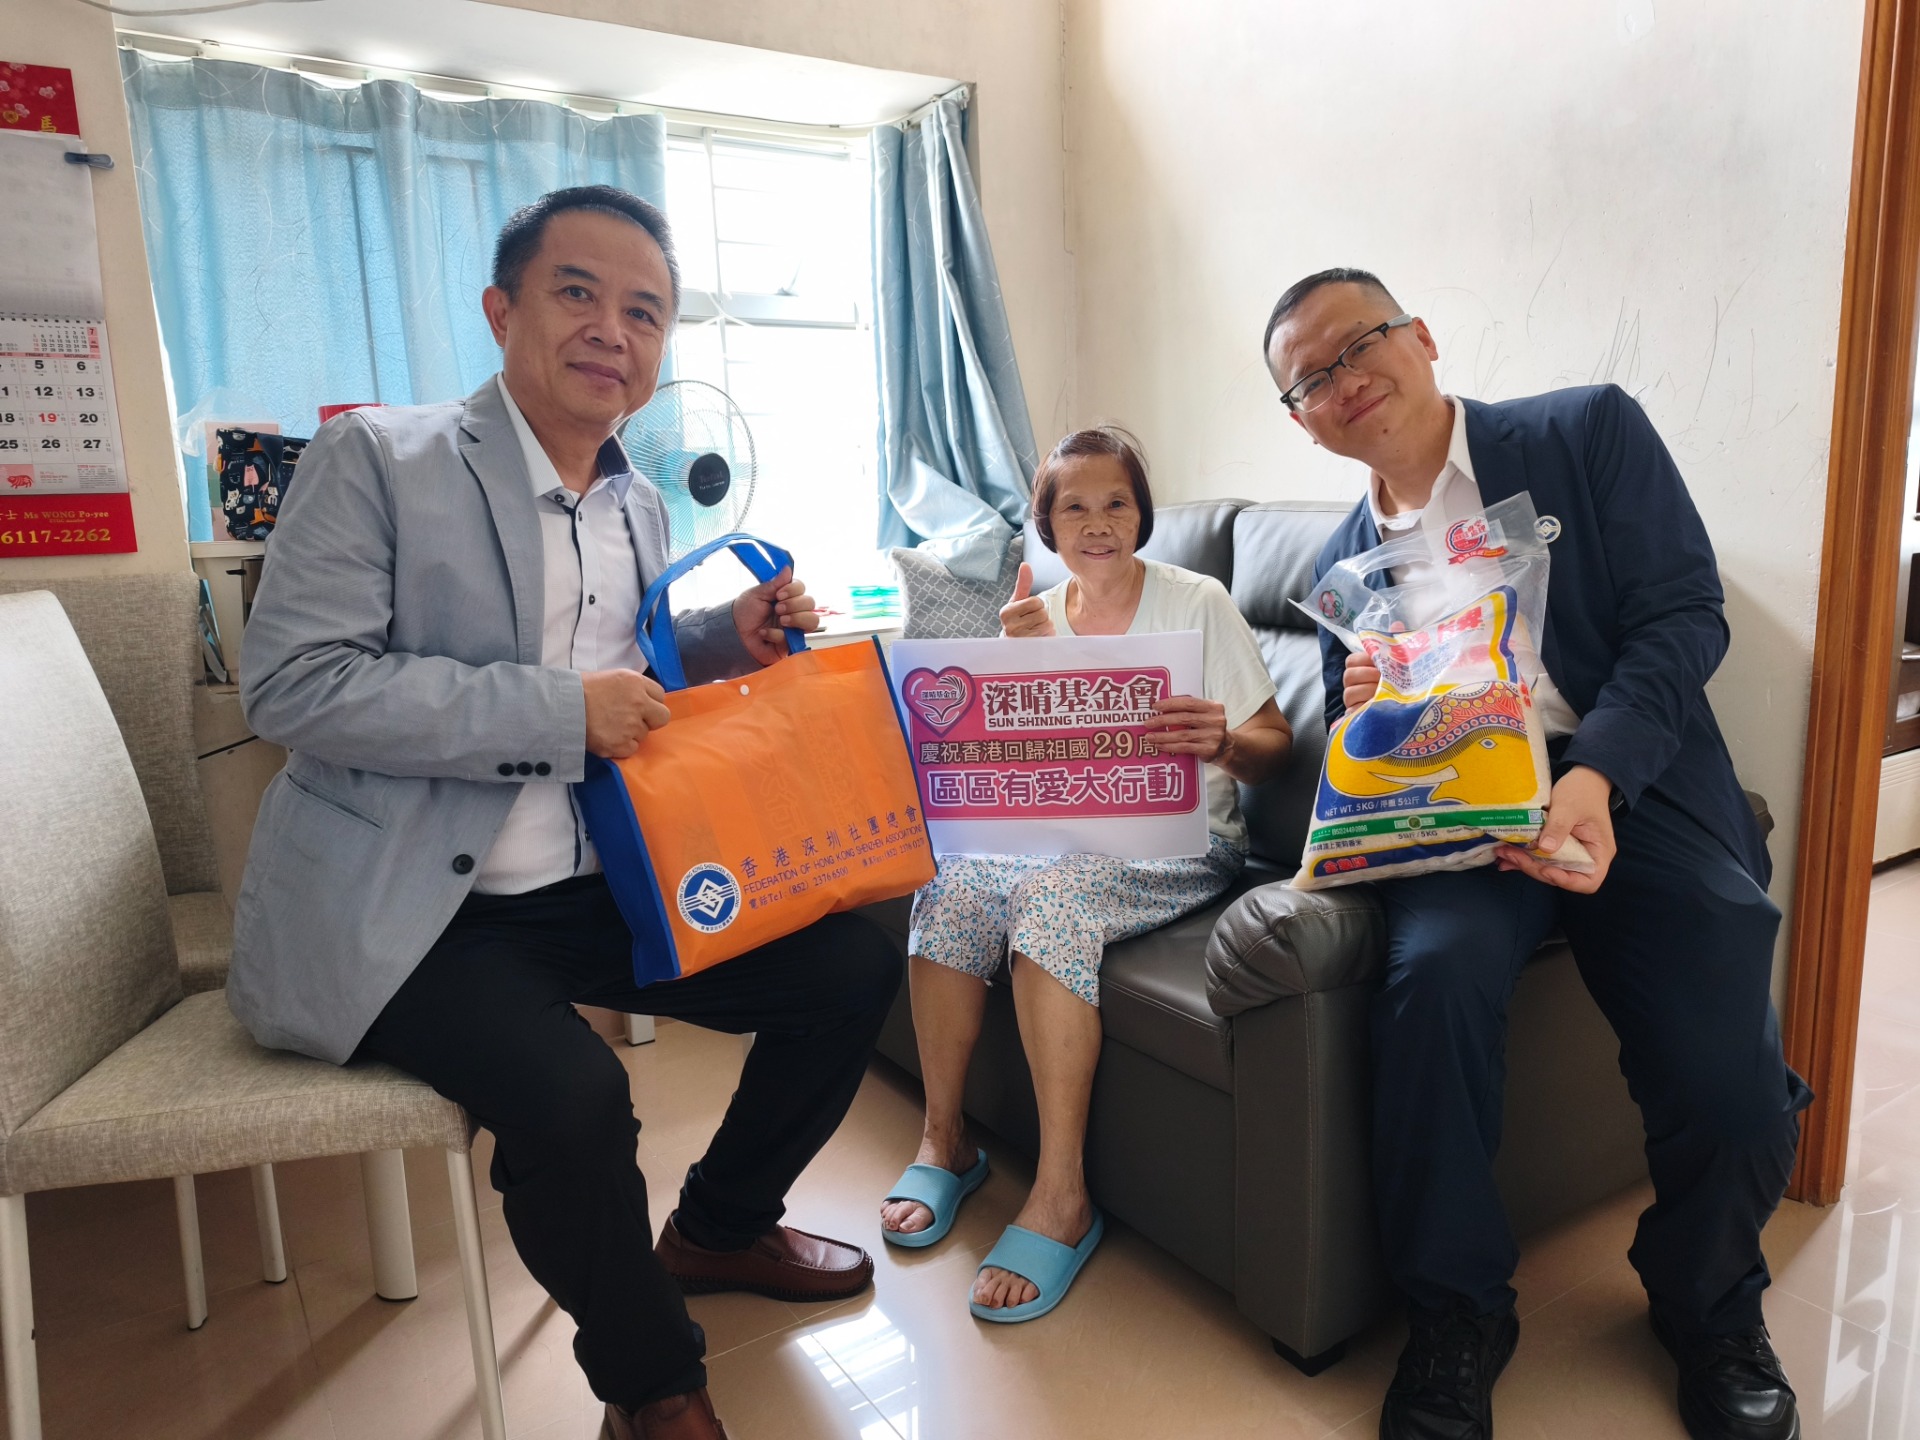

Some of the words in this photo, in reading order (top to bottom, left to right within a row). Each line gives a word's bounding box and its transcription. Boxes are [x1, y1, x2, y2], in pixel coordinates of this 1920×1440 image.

[35, 360, 44, 370] 5
[77, 361, 86, 371] 6
[34, 386, 54, 396] 12
[76, 387, 95, 397] 13
[39, 413, 57, 423] 19
[79, 413, 98, 423] 20
[0, 440, 19, 449] 25
[41, 439, 61, 449] 26
[83, 439, 101, 449] 27
[41, 511, 75, 519] WONG
[79, 511, 109, 519] Po-yee
[1, 528, 111, 544] 6117-2262
[986, 677, 1161, 716] 深晴基金會
[988, 717, 1015, 728] SUN
[1017, 714, 1072, 727] SHINING
[920, 732, 1174, 763] 慶祝香港回歸祖國29周
[928, 764, 1184, 808] 區區有愛大行動
[1325, 807, 1338, 817] NET
[1340, 804, 1354, 814] WT.
[1356, 801, 1375, 811] 5KG
[1397, 796, 1420, 806] 5公斤
[740, 804, 917, 879] 香港深圳社團總會
[743, 868, 798, 895] FEDERATION
[800, 862, 811, 875] OF
[813, 854, 835, 870] HONG
[836, 847, 855, 863] KONG
[885, 823, 923, 845] ASSOCIATIONS
